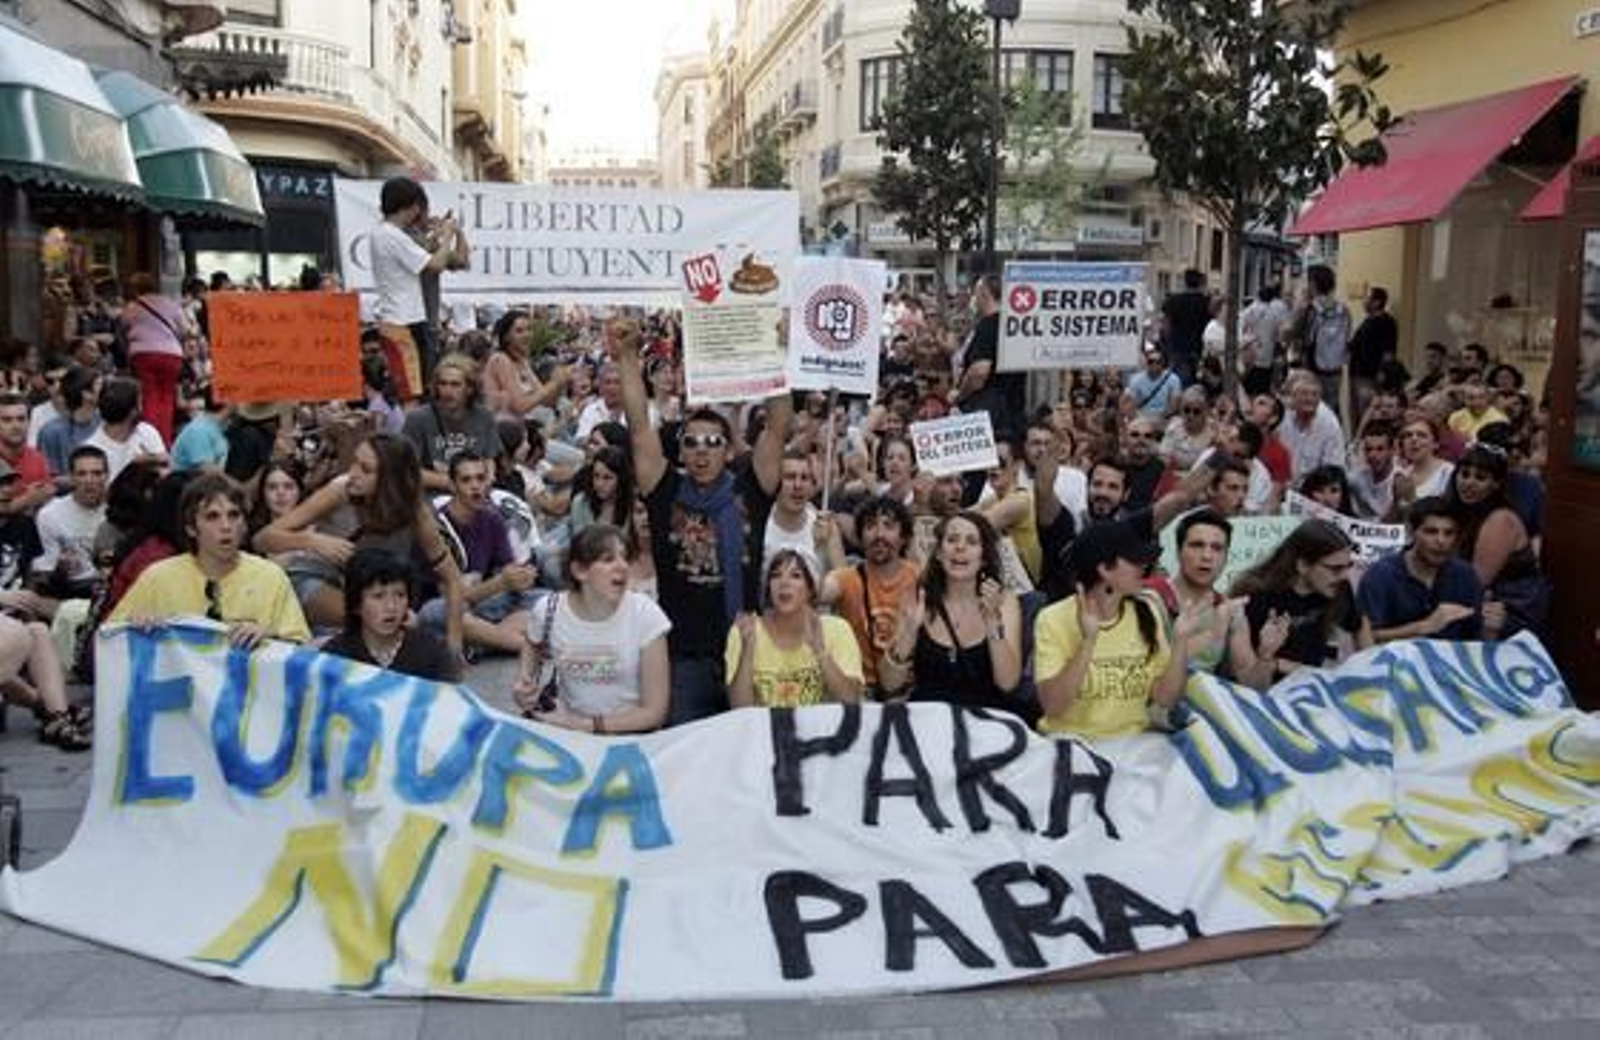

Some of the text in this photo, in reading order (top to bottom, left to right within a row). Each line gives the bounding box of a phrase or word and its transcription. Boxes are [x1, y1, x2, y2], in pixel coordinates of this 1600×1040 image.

[685, 256, 718, 291] NO
[1041, 289, 1137, 310] ERROR
[1050, 315, 1139, 337] SISTEMA
[769, 701, 1121, 840] PARA
[187, 812, 1203, 997] NO PARA
